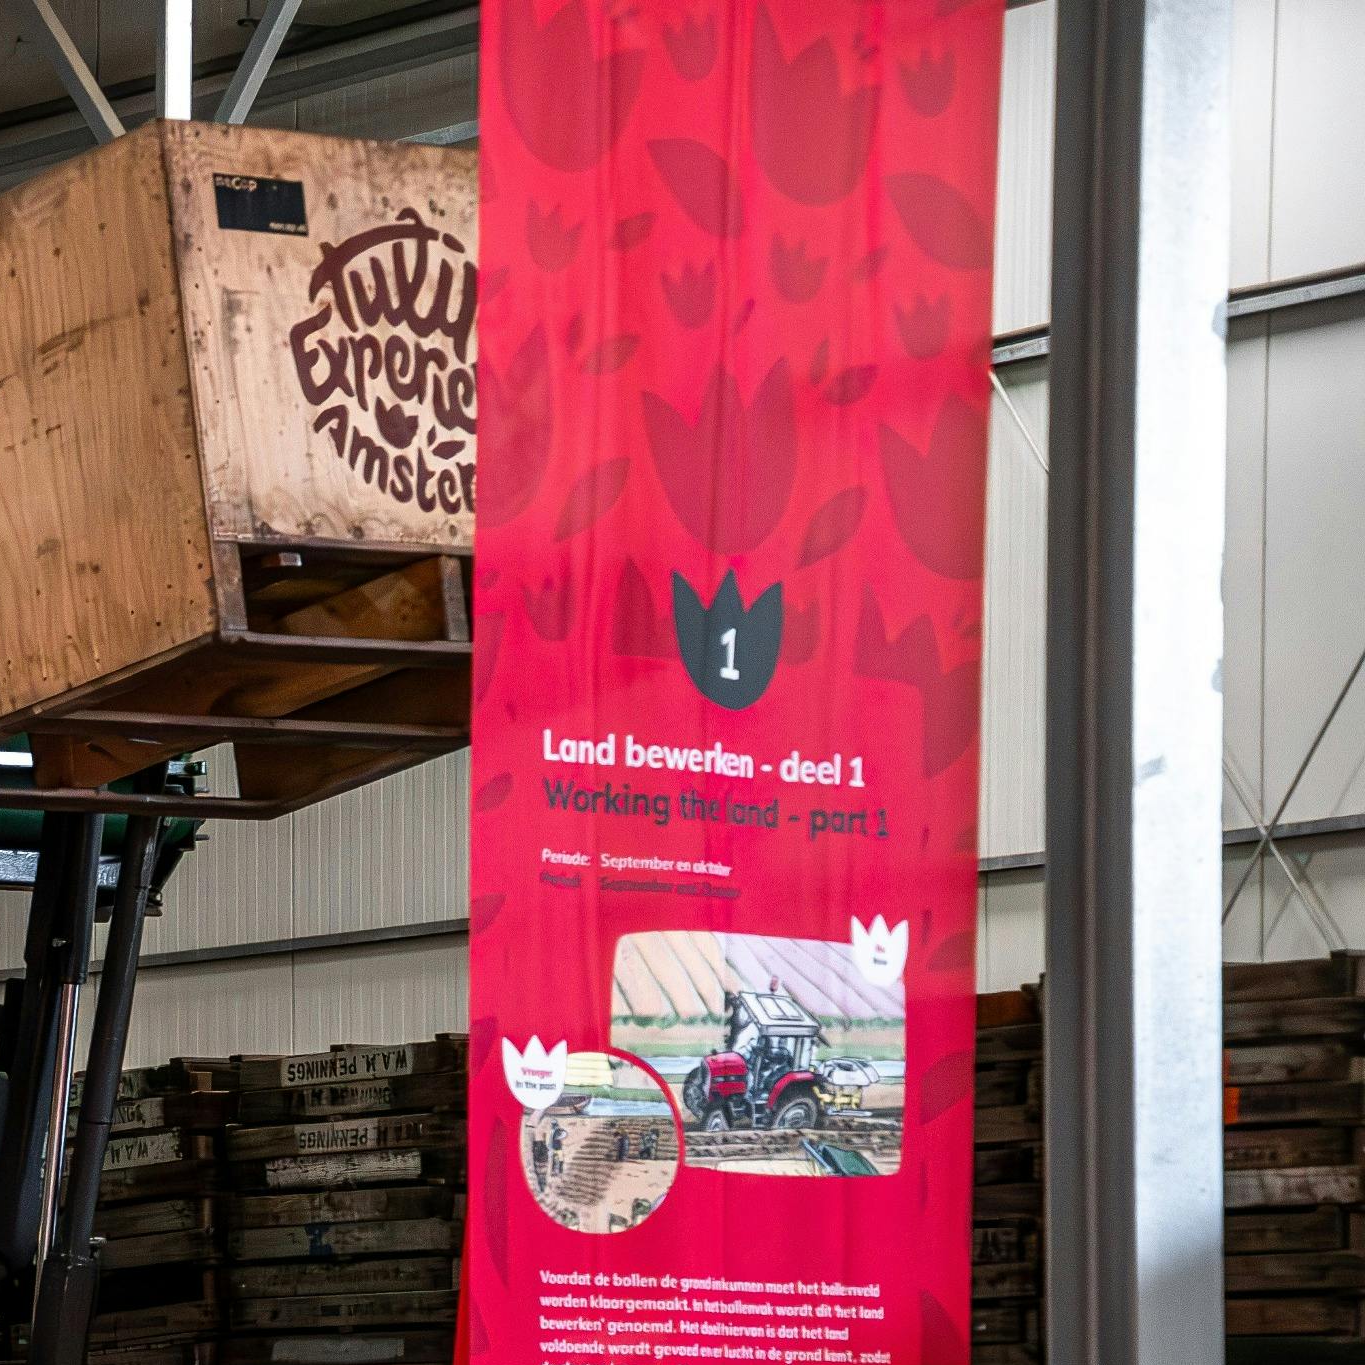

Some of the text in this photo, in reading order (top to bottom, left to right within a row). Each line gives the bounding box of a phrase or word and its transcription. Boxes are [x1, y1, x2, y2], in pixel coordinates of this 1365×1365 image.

[719, 627, 740, 680] 1
[543, 729, 616, 766] Land
[624, 734, 754, 779] bewerken
[780, 751, 841, 785] deel
[849, 757, 864, 787] 1
[544, 779, 671, 827] Working
[680, 788, 721, 822] the
[727, 793, 780, 829] land
[809, 805, 868, 841] part
[877, 809, 889, 837] 1
[601, 854, 674, 870] September
[287, 1055, 357, 1082] PENNINGS
[299, 1127, 368, 1149] PENNINGS
[540, 1270, 591, 1285] Voordat
[594, 1273, 610, 1286] de
[613, 1273, 657, 1287] bollen
[660, 1275, 678, 1288] de
[540, 1295, 587, 1308] worden
[608, 1321, 676, 1335] genoemd.
